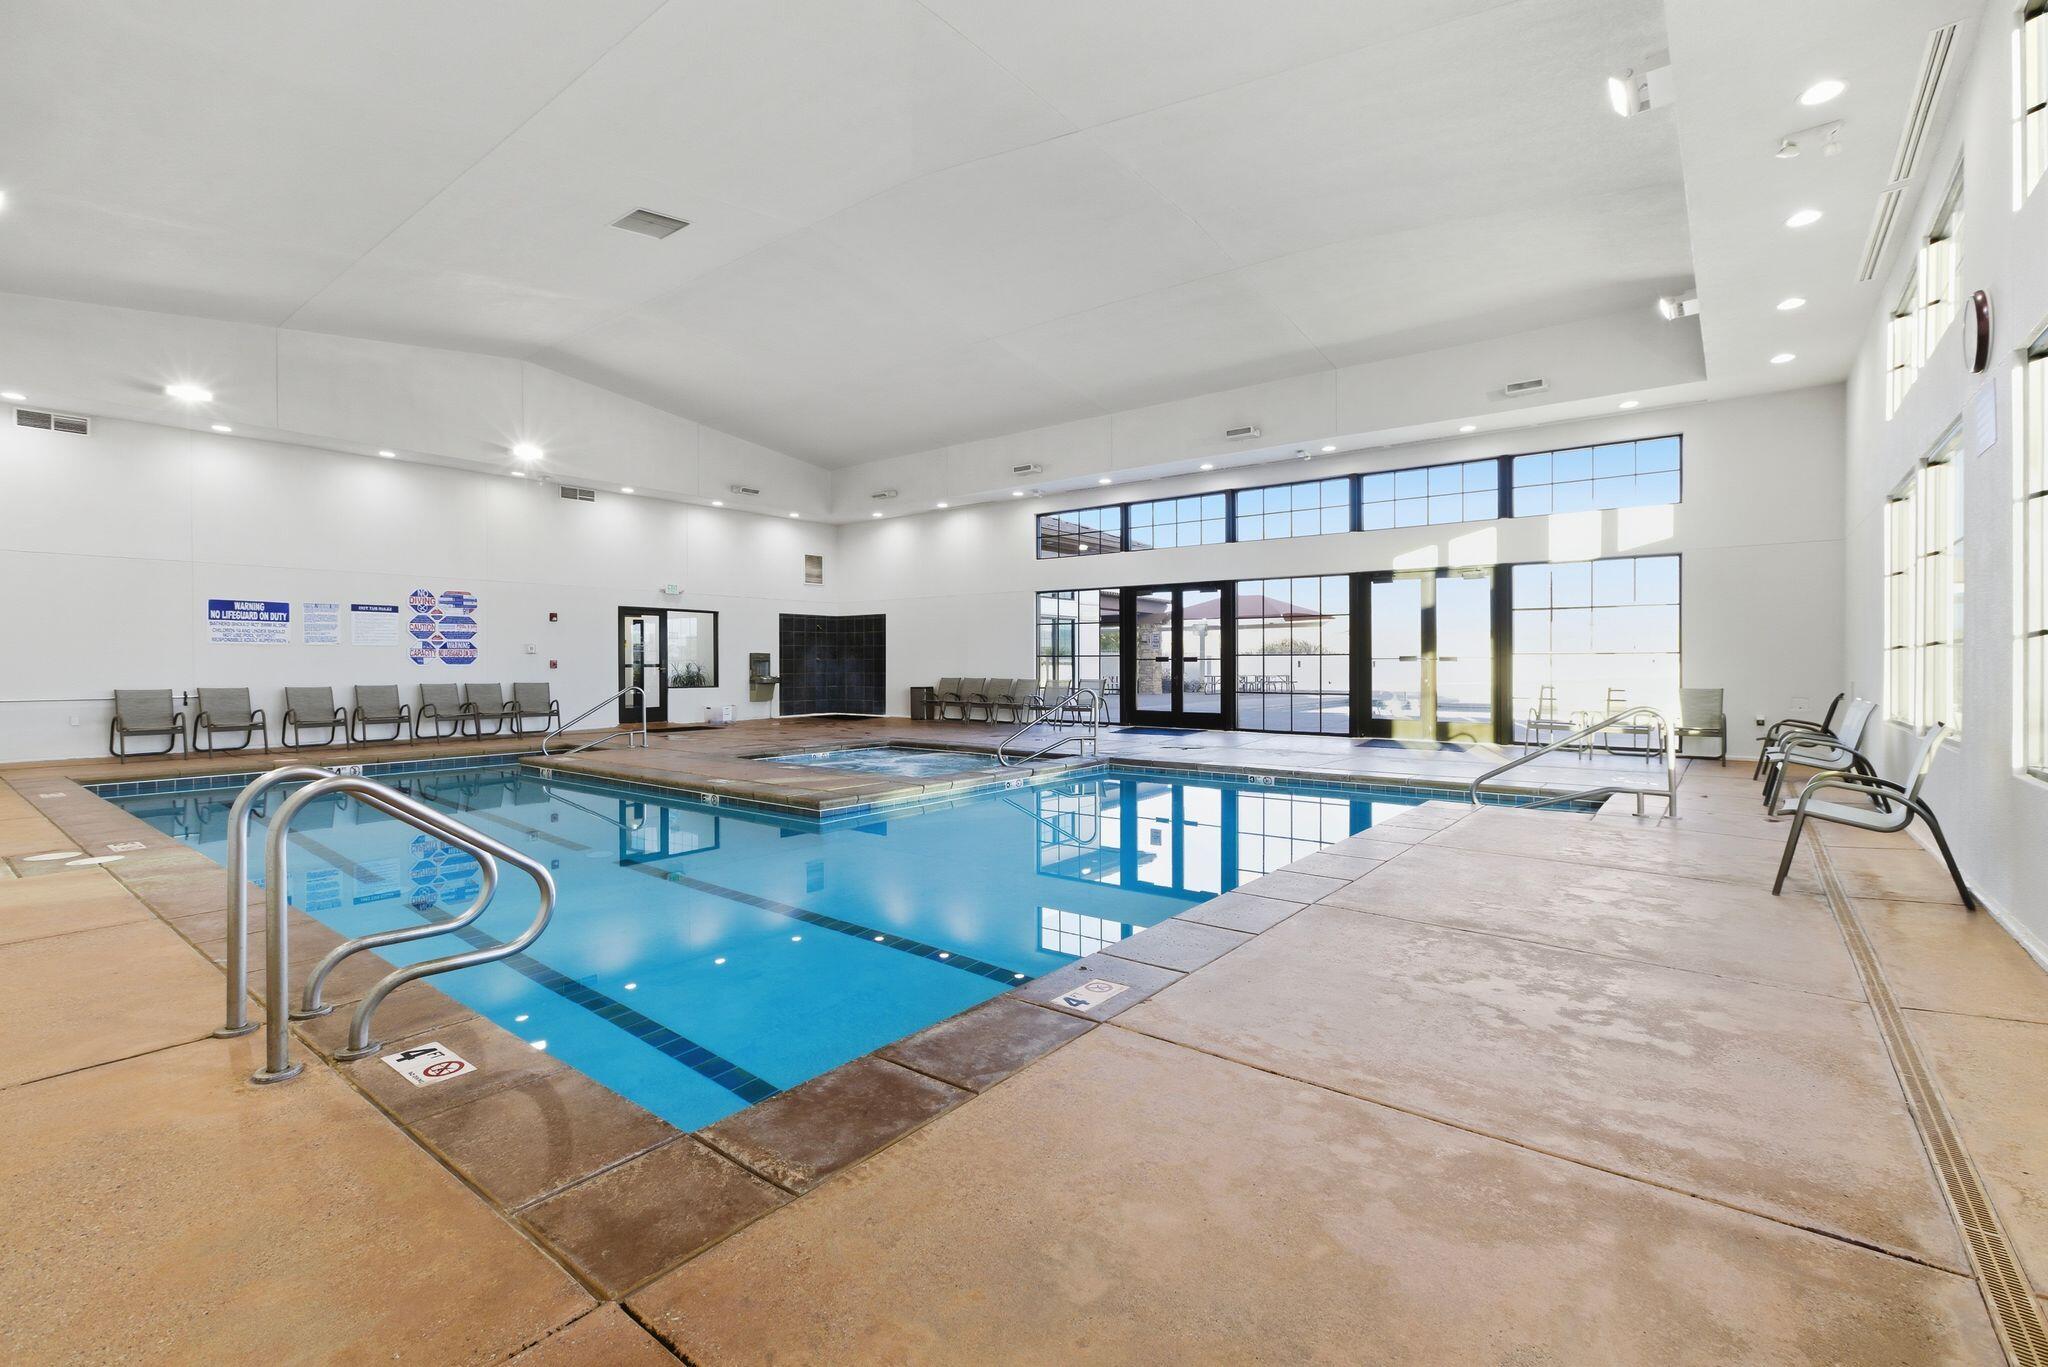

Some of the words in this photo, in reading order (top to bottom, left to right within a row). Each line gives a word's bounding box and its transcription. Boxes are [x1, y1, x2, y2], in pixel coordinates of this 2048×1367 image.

[417, 588, 428, 597] NO
[409, 597, 436, 605] DIVING
[234, 601, 265, 611] WARNING
[210, 610, 220, 619] NO
[221, 610, 258, 620] LIFEGUARD
[259, 612, 269, 620] ON
[270, 612, 287, 621] DUTY
[409, 623, 436, 632] CAUTION
[447, 641, 471, 649] WARNING
[1063, 996, 1091, 1007] 4
[396, 1047, 438, 1062] 4
